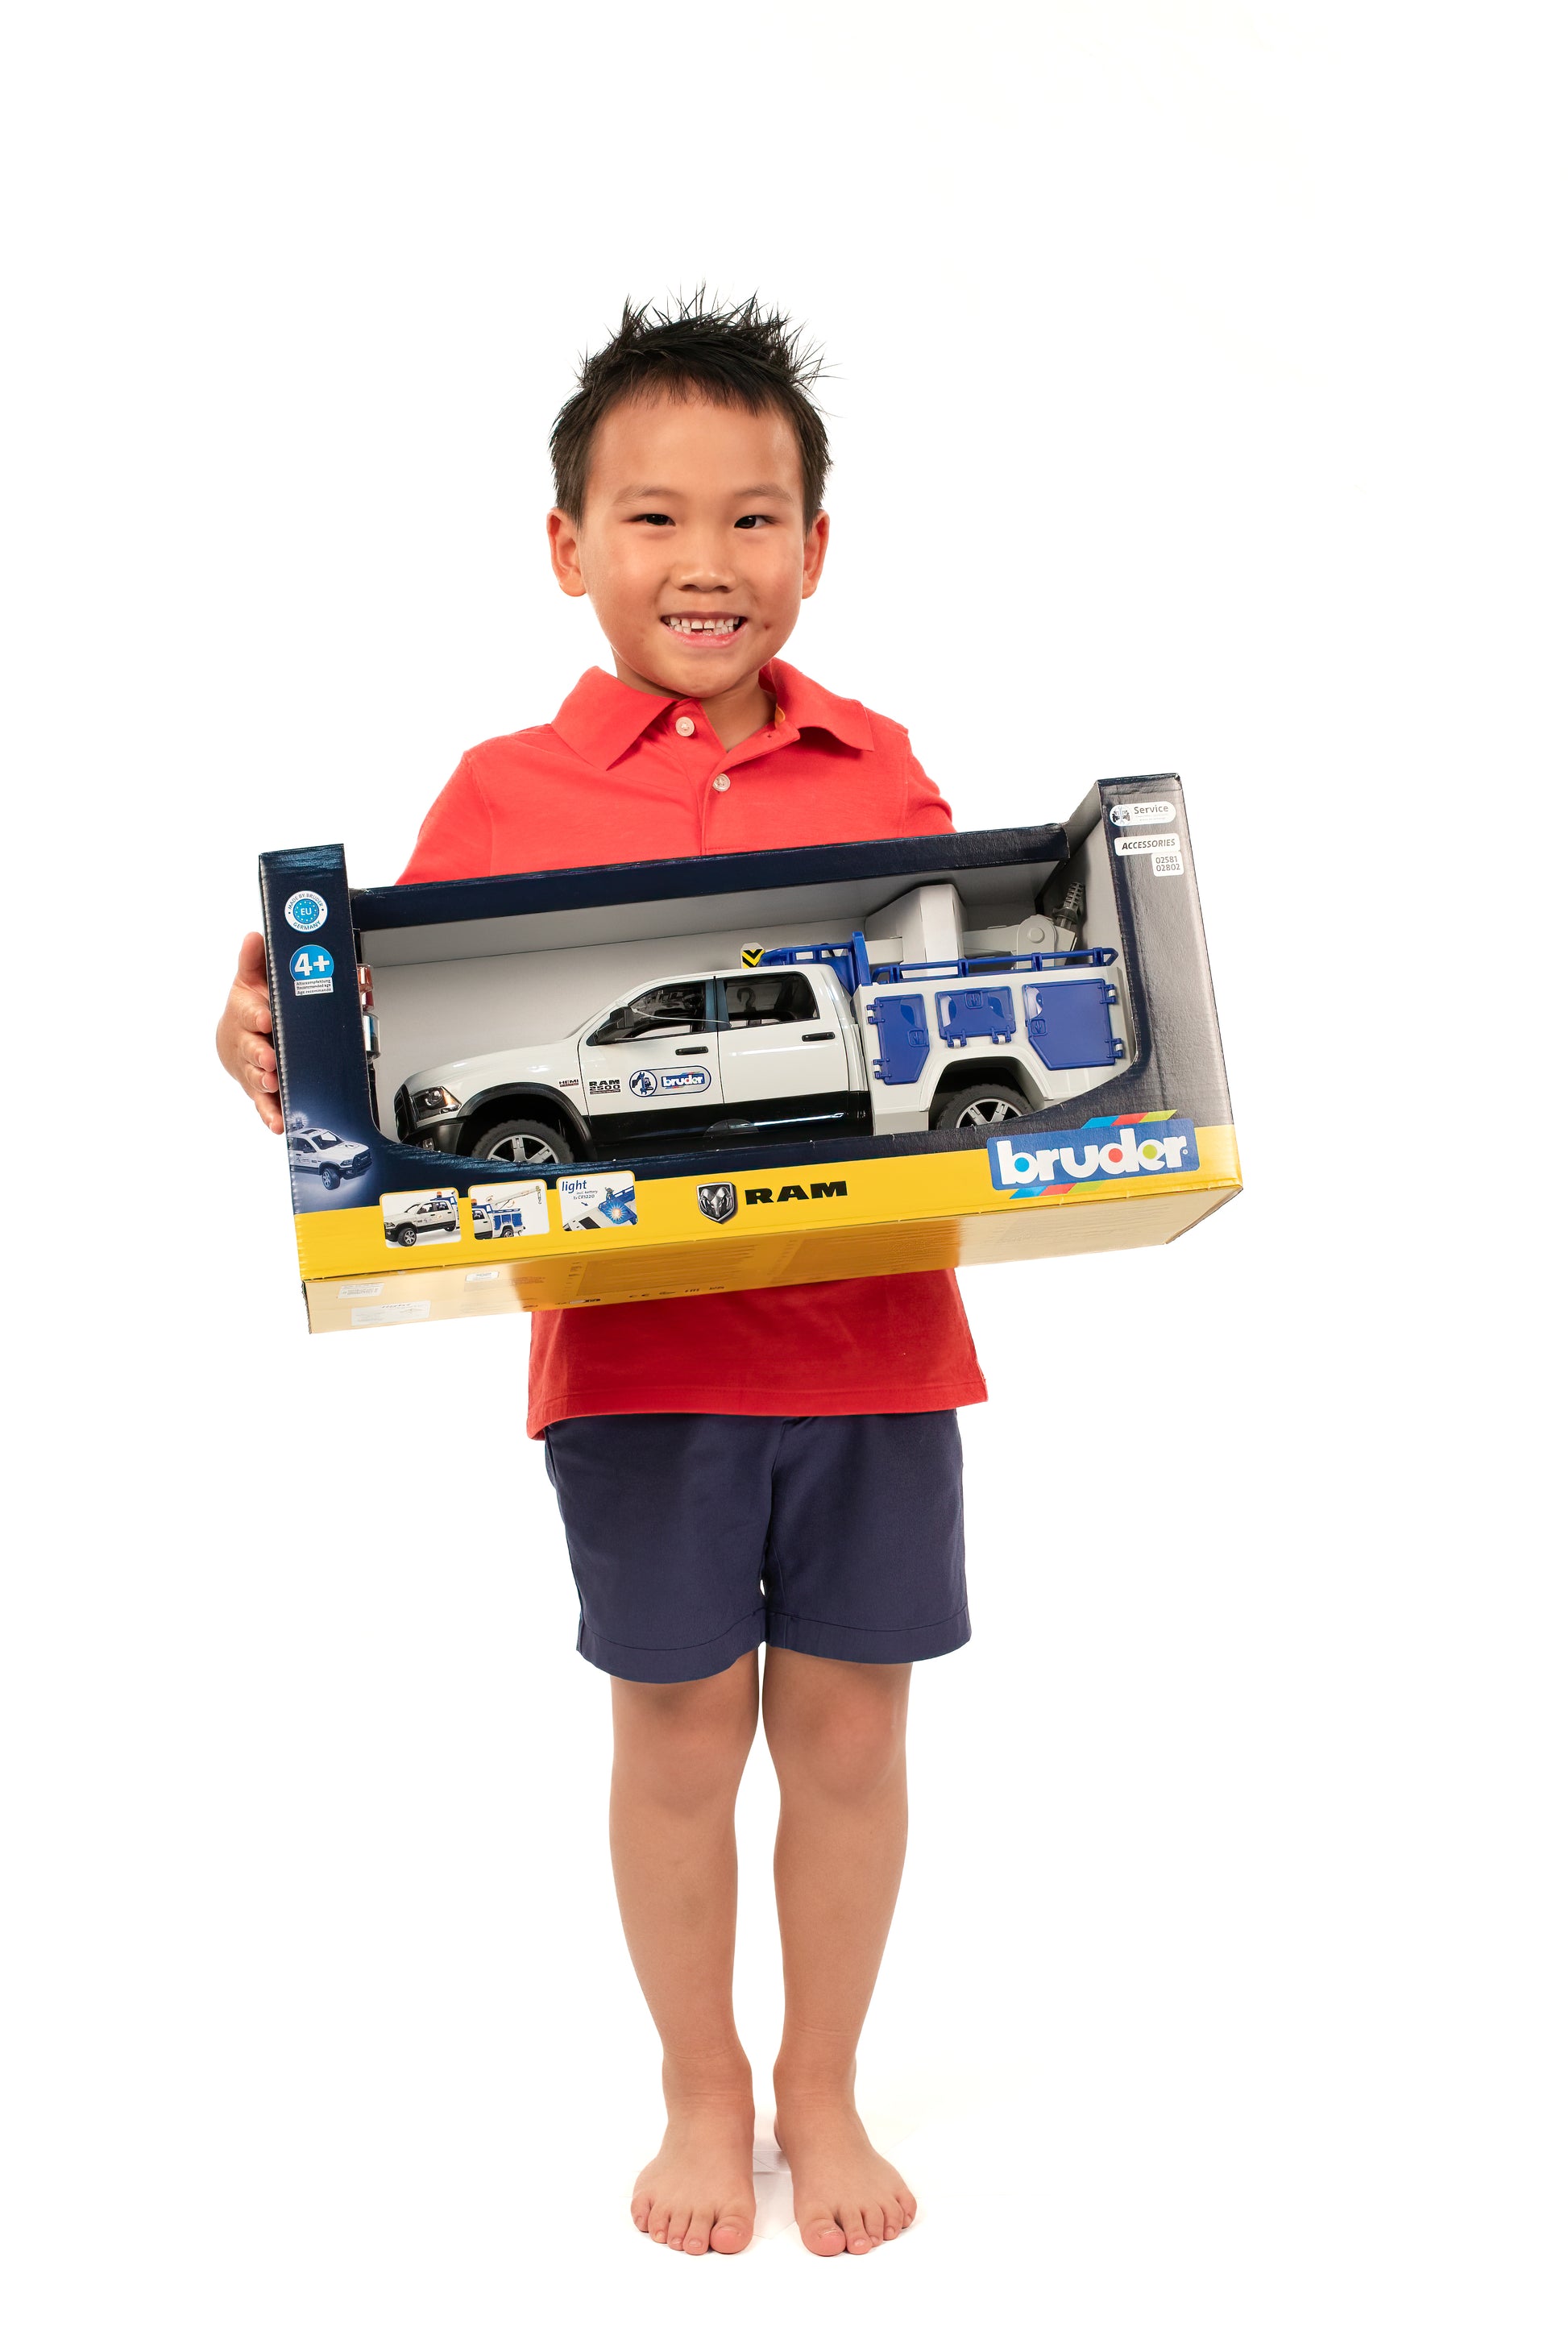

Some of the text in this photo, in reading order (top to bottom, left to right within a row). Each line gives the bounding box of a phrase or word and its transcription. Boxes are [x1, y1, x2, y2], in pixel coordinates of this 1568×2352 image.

[1134, 804, 1168, 815] Service
[1122, 839, 1176, 850] ACCESSORIES
[1155, 856, 1178, 864] 02581
[1156, 863, 1180, 872] 02802
[288, 895, 300, 910] MADE
[306, 893, 324, 906] BRUDER
[300, 907, 312, 916] EU
[292, 920, 321, 931] GERMANY
[294, 952, 330, 977] 4+
[588, 1079, 620, 1087] RAM
[662, 1073, 704, 1087] bruder
[996, 1128, 1188, 1185] bruder
[562, 1180, 587, 1194] light
[745, 1180, 848, 1205] RAM
